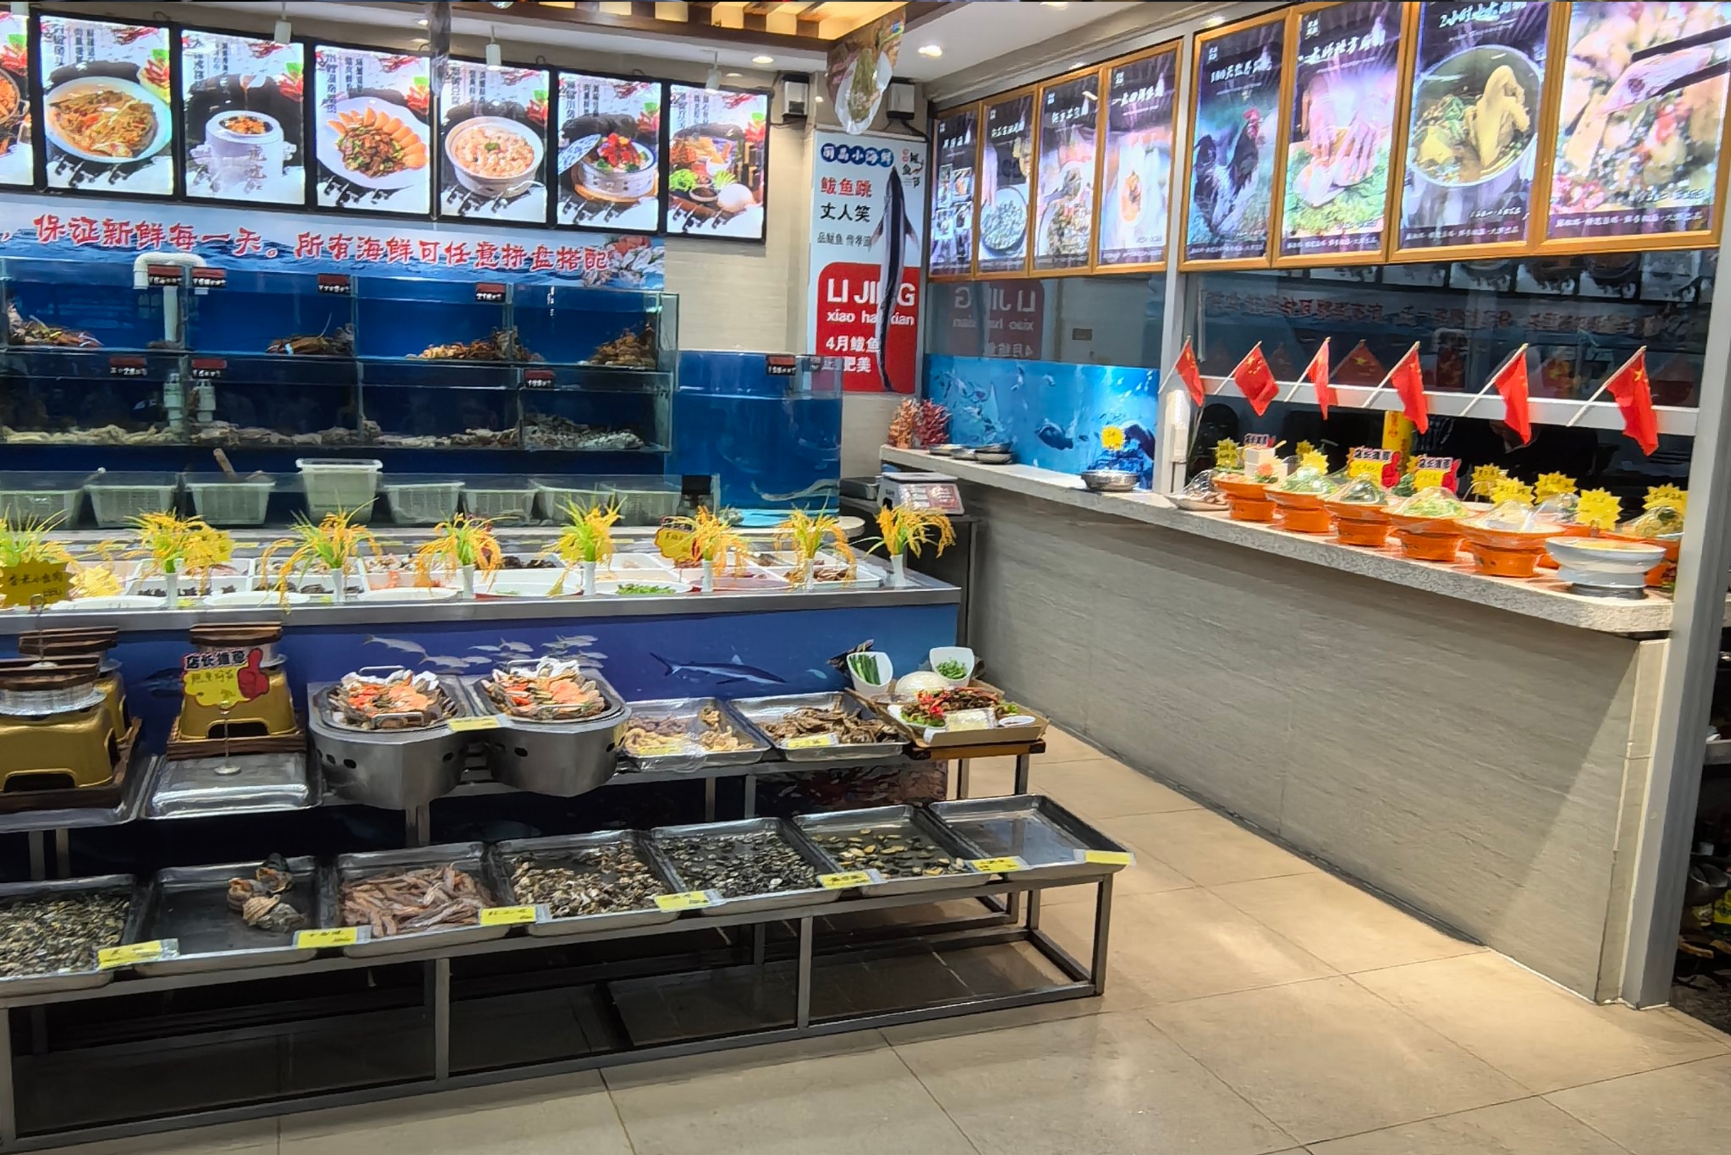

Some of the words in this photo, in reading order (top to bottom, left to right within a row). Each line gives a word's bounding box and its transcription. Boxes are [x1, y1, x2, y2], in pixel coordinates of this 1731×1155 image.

[821, 176, 872, 198] 鲅鱼跳
[820, 202, 871, 222] 丈人笑
[827, 278, 849, 303] LI
[853, 280, 916, 306] JIG
